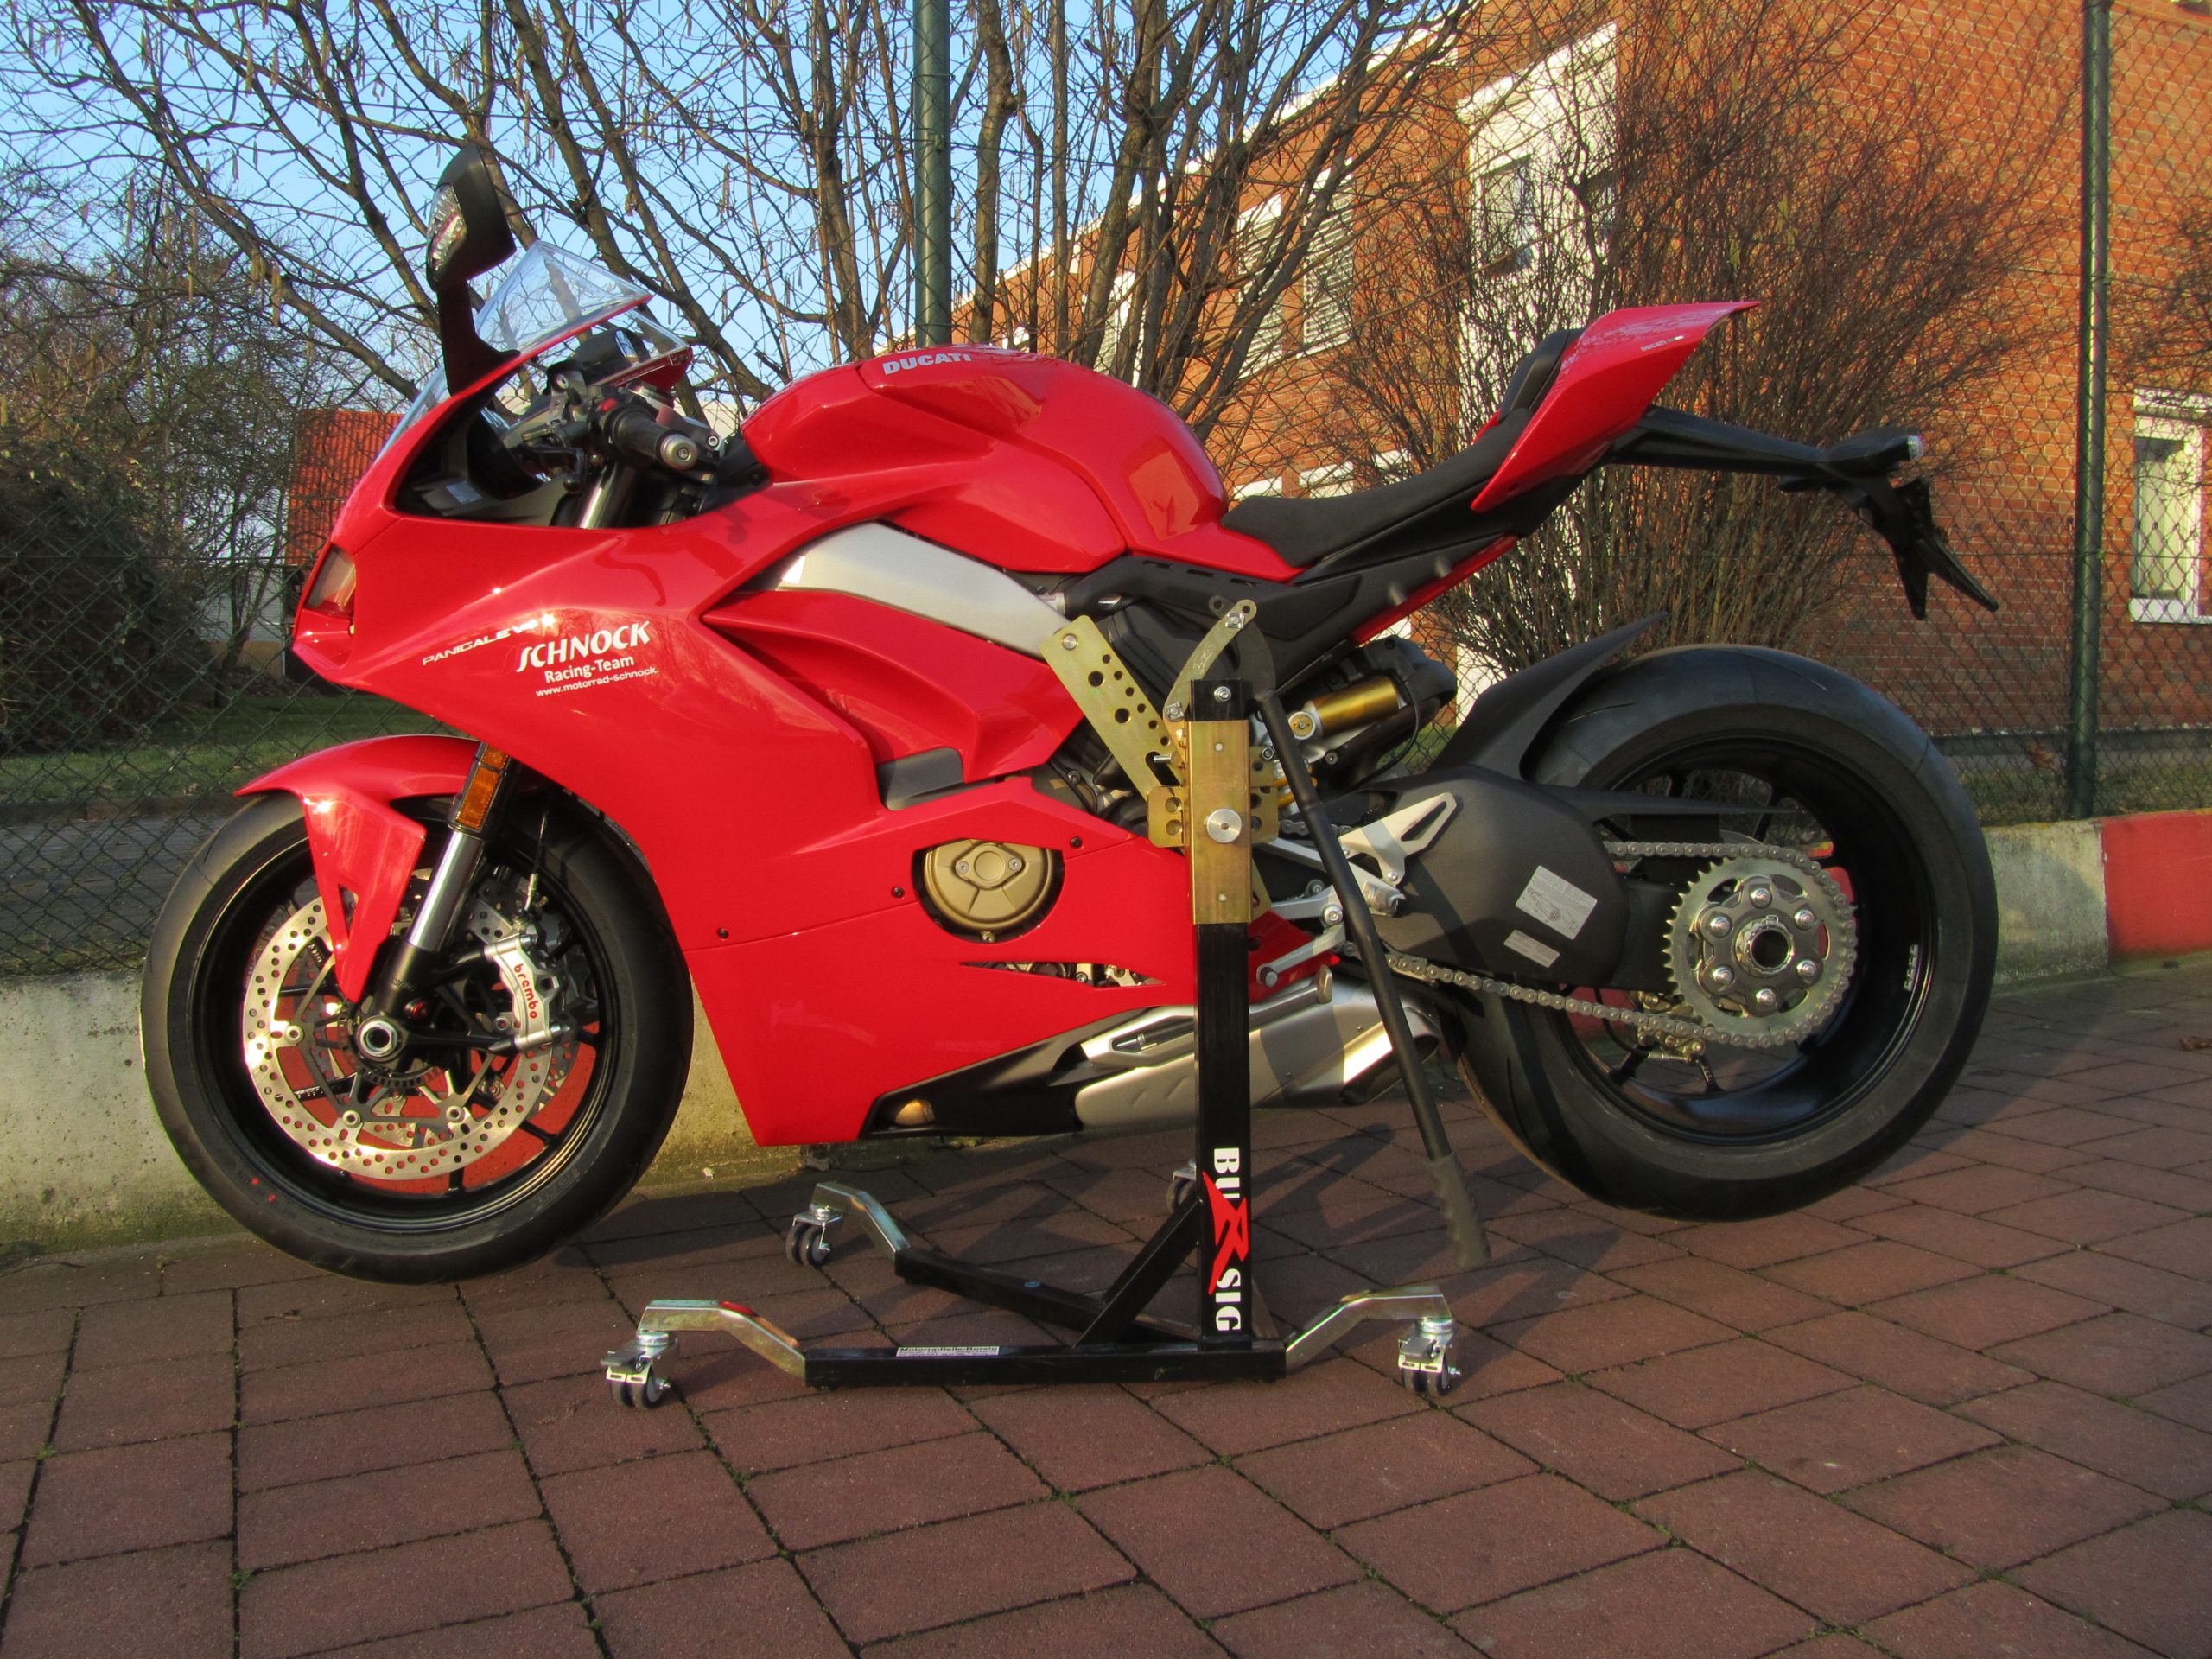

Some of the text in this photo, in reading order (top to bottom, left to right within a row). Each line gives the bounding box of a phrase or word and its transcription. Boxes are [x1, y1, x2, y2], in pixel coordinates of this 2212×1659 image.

[882, 353, 971, 375] DUCATI
[423, 628, 512, 665] PANIGALE
[516, 620, 650, 672] SCHNOCK
[544, 656, 634, 683] Racing-Team
[514, 963, 539, 1019] brembo
[1203, 1147, 1249, 1332] BURSIG
